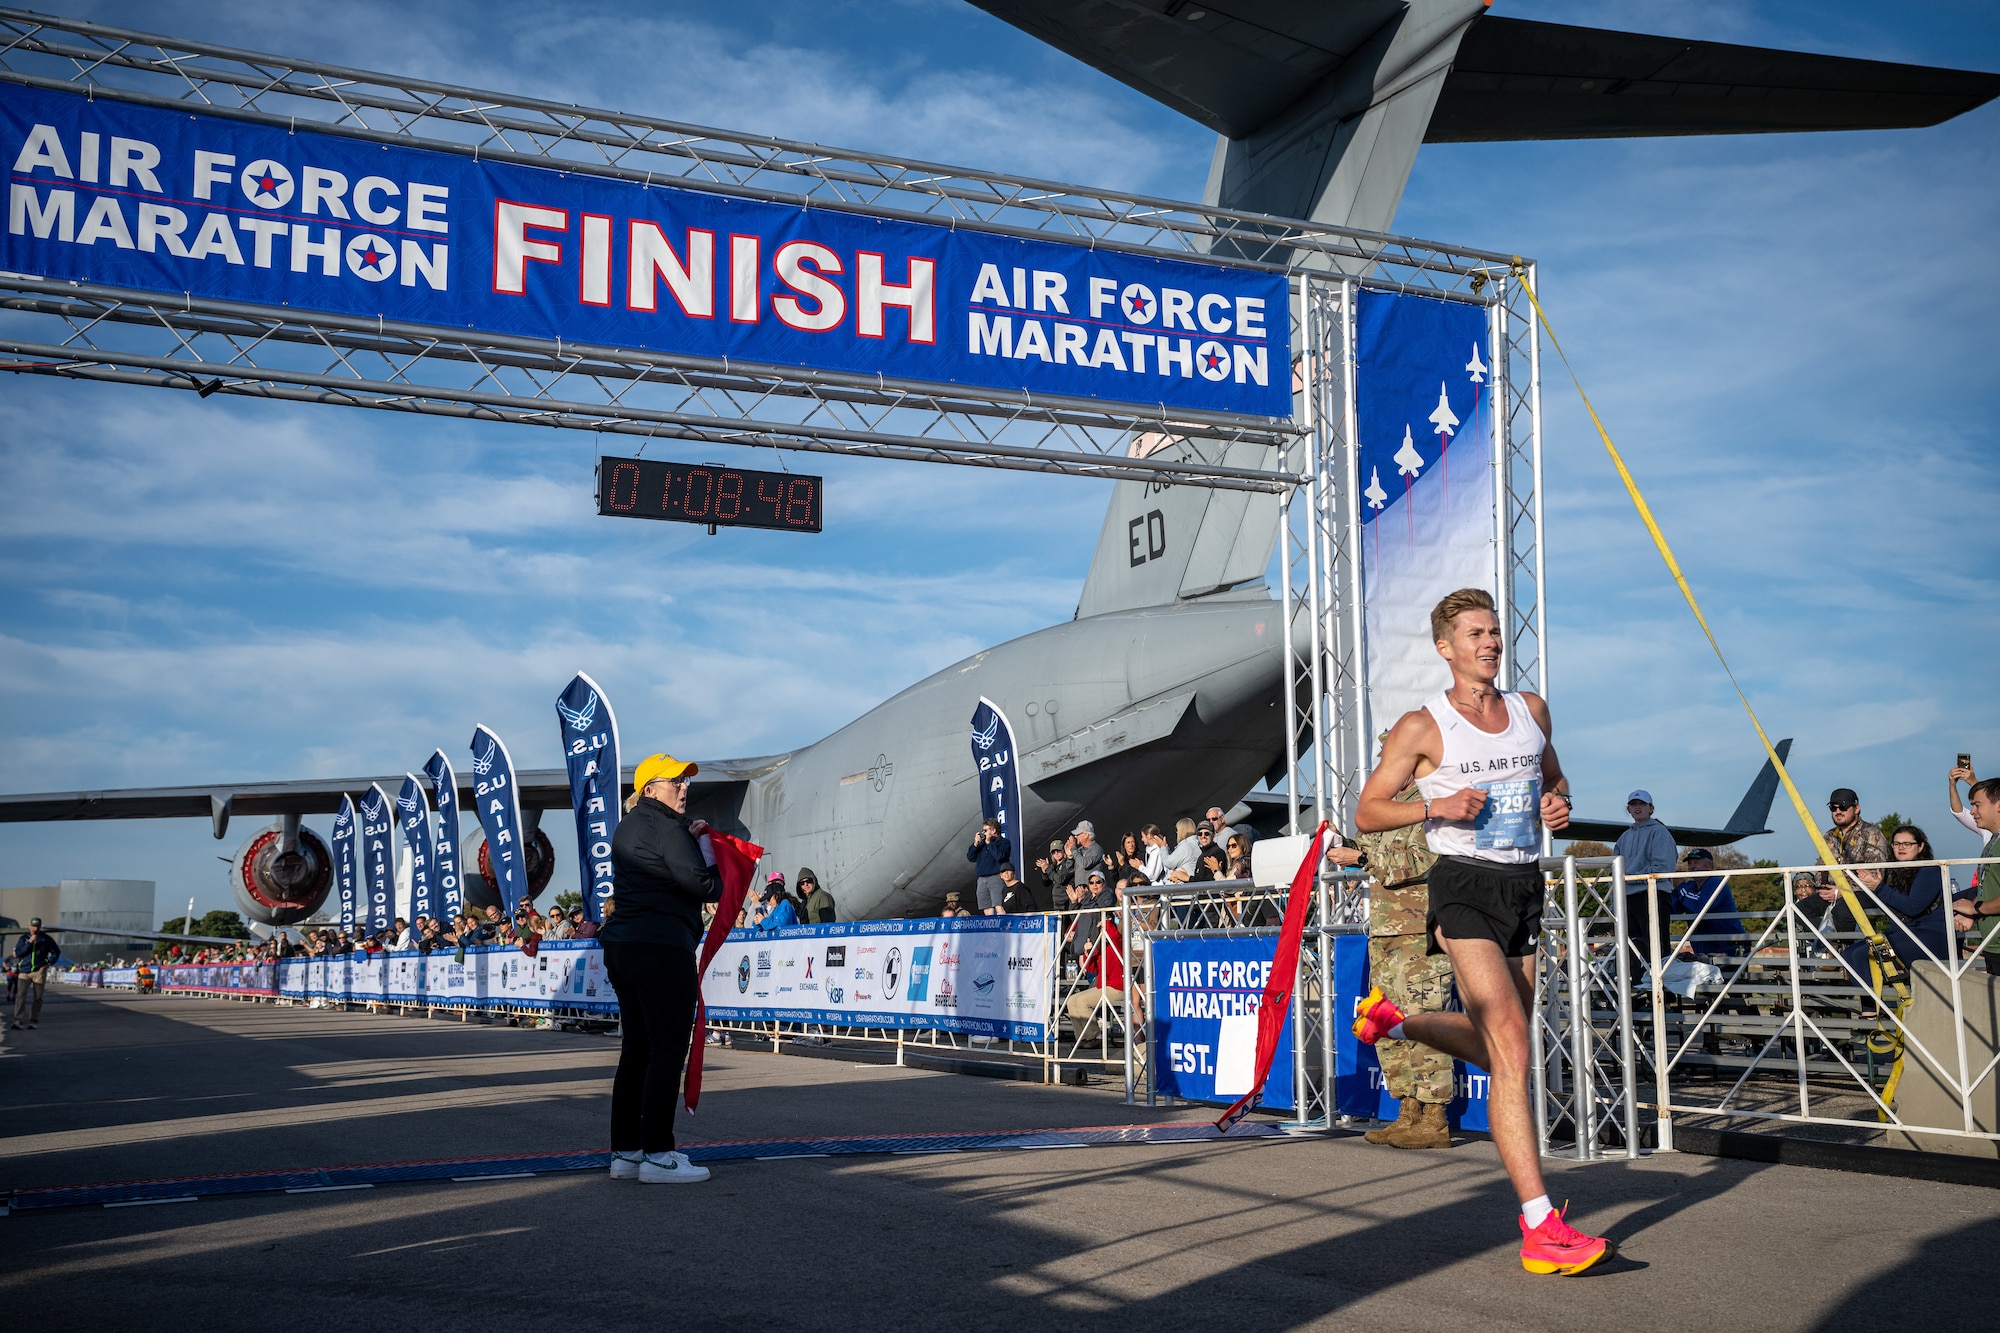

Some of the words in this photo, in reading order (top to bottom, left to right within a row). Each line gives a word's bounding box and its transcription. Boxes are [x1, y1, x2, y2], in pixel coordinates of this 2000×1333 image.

[13, 124, 163, 193] AIR
[193, 150, 449, 234] FORCE
[8, 183, 449, 291] MARATHON
[492, 198, 936, 345] FINISH
[970, 263, 1070, 314] AIR
[1090, 277, 1267, 338] FORCE
[968, 312, 1269, 386] MARATHON
[1129, 509, 1166, 568] ED
[1460, 761, 1484, 774] U.S.
[1489, 758, 1508, 770] AIR
[1491, 783, 1504, 791] AIR
[1506, 781, 1529, 790] FORCE
[1491, 788, 1529, 796] MARATHON
[1504, 817, 1523, 825] Jacob
[951, 918, 1001, 930] USAFMARATHON.COM
[1018, 919, 1042, 929] #FLYAFM
[1018, 957, 1033, 968] HOIST
[1169, 961, 1203, 987] AIR
[1208, 960, 1274, 988] FORCE
[800, 983, 819, 991] EXCHANGE
[941, 979, 952, 994] City
[830, 988, 844, 1004] KBR
[1169, 991, 1264, 1019] MARATHO
[1015, 1026, 1038, 1037] #FLYAFM
[1170, 1042, 1214, 1075] EST.
